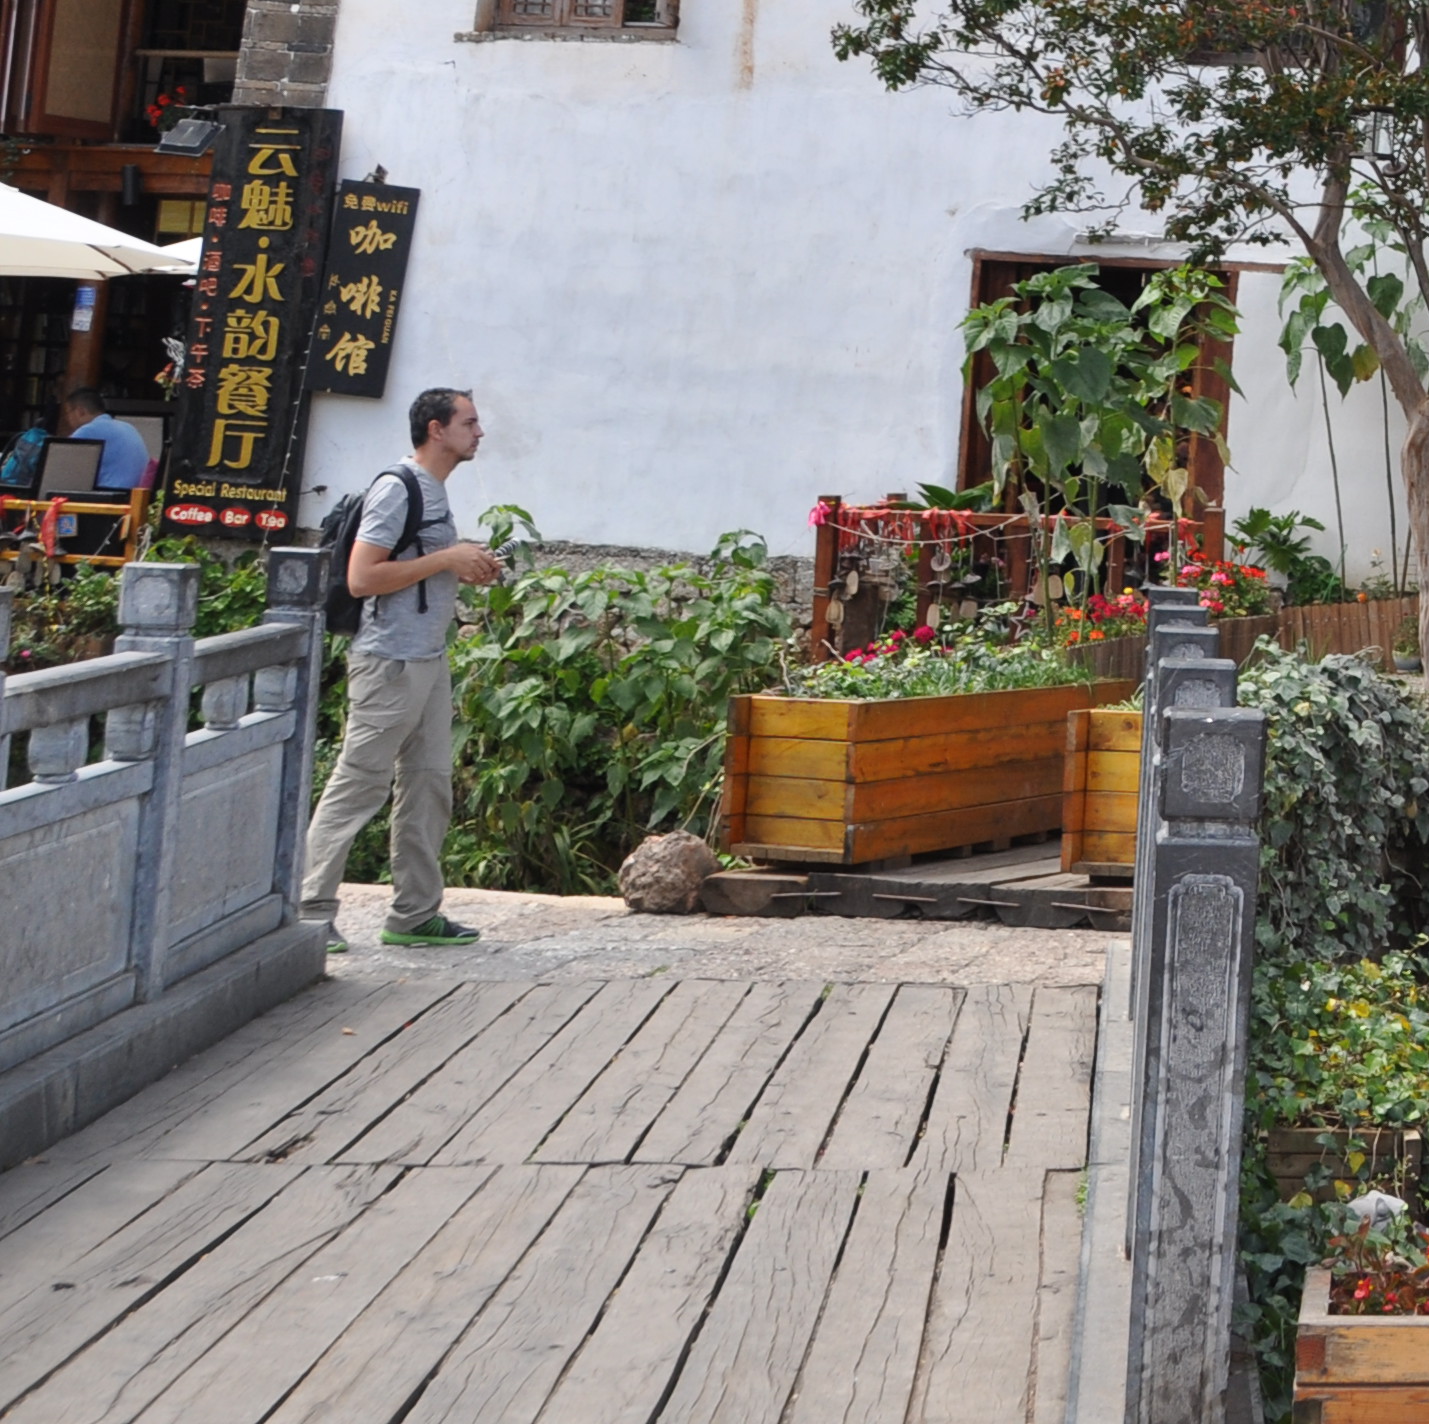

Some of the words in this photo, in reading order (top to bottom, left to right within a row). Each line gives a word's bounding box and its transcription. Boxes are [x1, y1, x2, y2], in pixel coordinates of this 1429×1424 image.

[325, 219, 397, 377] 咖啡馆
[173, 479, 217, 498] Special
[220, 483, 287, 502] Restaurant
[170, 506, 213, 523] Coffee
[224, 510, 249, 525] Bar
[260, 512, 286, 528] Tea
